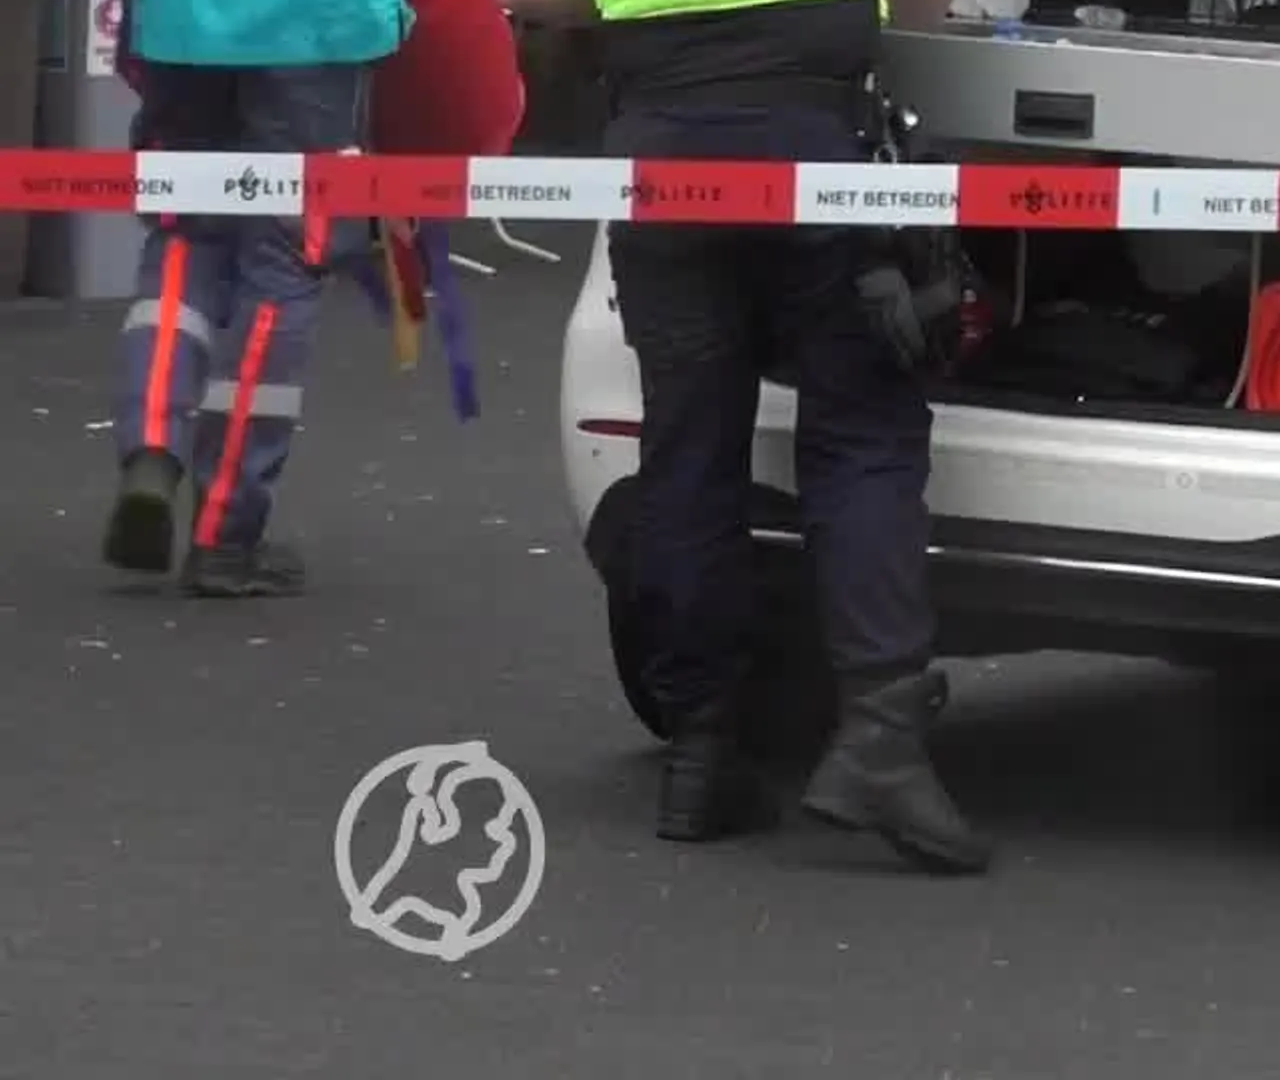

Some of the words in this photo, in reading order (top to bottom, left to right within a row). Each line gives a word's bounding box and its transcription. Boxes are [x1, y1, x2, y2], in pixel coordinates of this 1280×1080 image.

[469, 185, 571, 202] BETREDEN
[816, 190, 859, 207] NIET
[863, 191, 961, 209] BETREDEN
[1203, 197, 1247, 214] NIET
